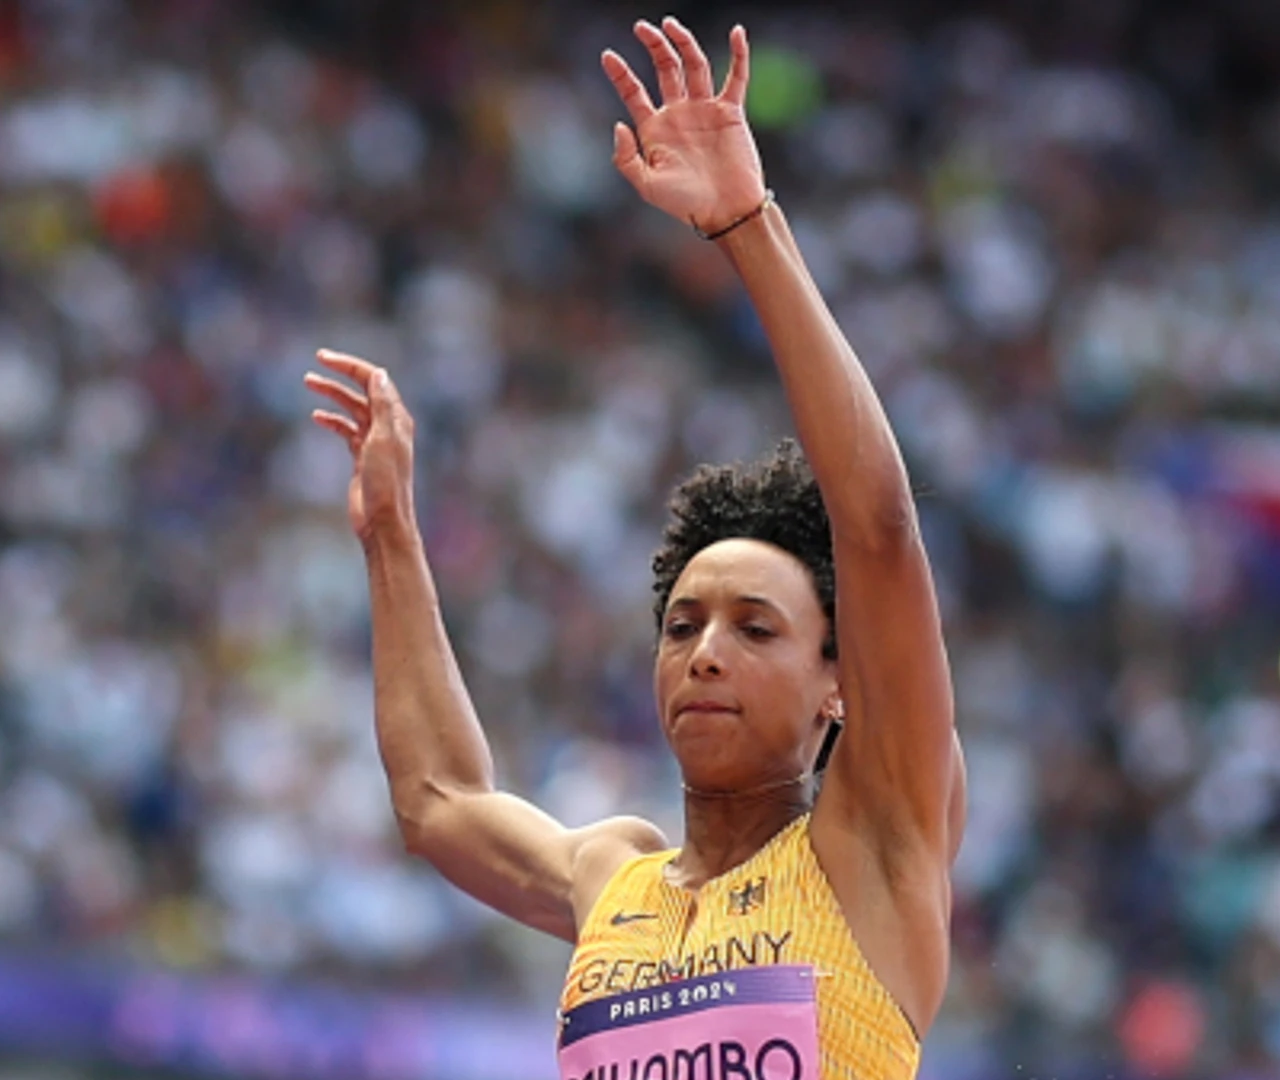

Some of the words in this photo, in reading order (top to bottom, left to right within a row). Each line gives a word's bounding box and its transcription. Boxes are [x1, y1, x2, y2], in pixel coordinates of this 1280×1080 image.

[578, 930, 792, 993] GERMANY
[610, 993, 673, 1021] PARIS
[678, 980, 737, 1006] 2024
